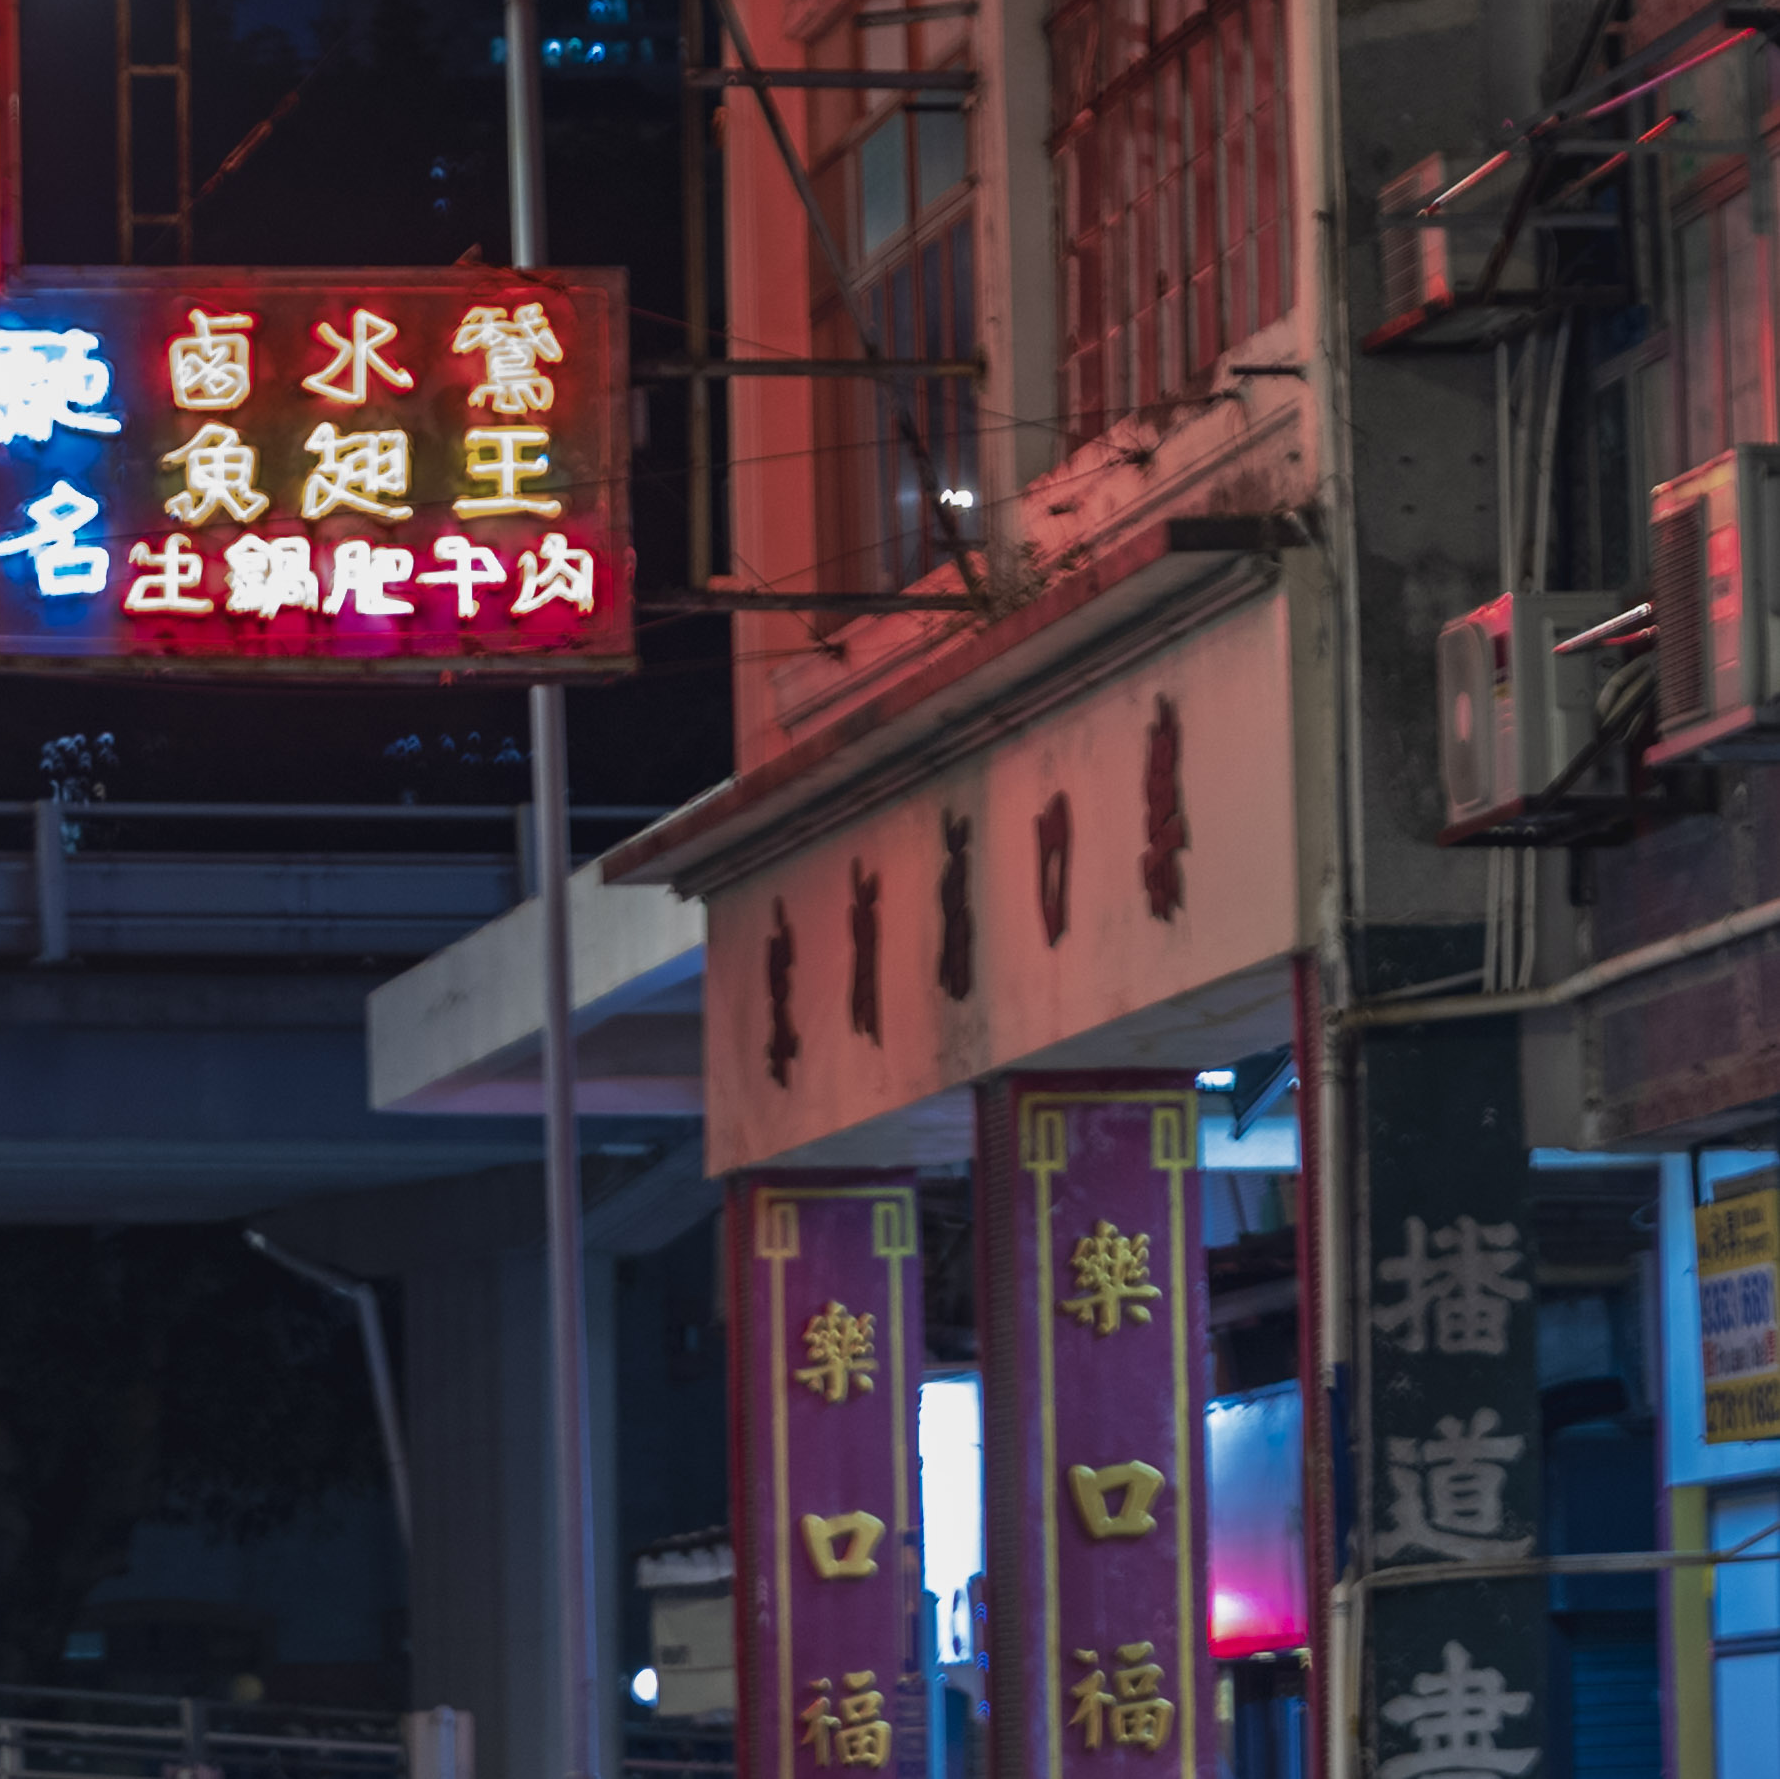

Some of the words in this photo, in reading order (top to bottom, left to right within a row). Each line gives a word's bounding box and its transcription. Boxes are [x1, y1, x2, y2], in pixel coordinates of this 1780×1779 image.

[793, 1298, 894, 1770] 樂口福
[1057, 1218, 1177, 1754] 樂口福
